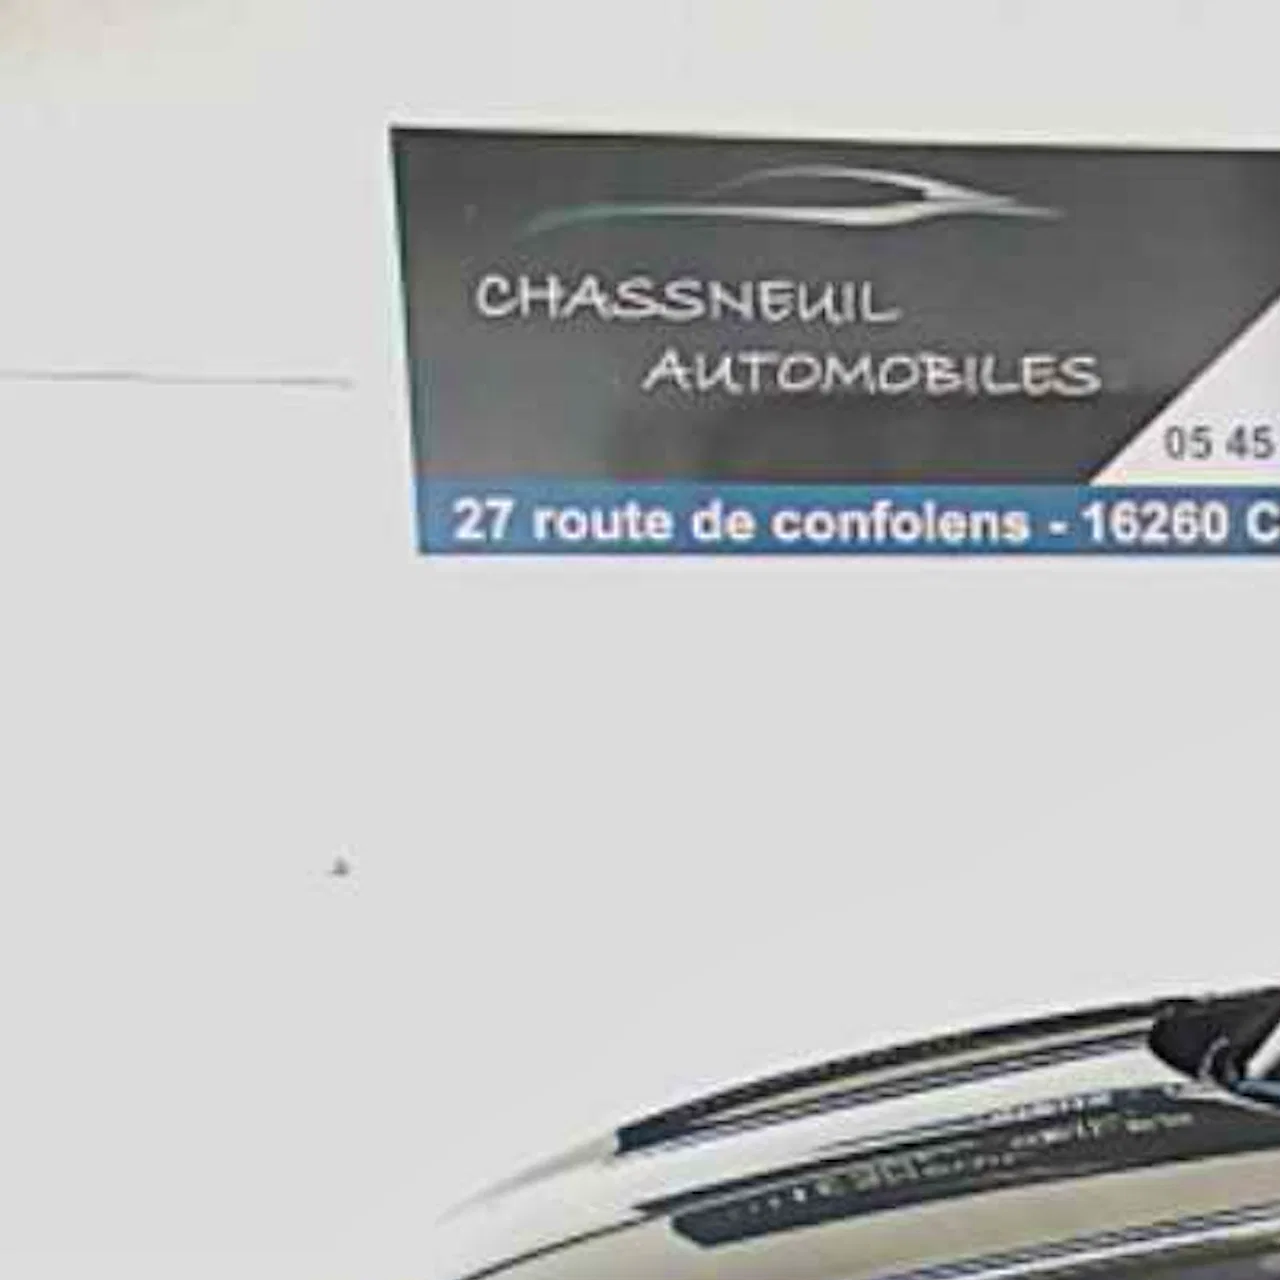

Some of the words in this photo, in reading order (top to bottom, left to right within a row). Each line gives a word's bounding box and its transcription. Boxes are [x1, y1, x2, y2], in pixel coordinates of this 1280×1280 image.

[474, 273, 902, 326] CHASSNEUIL
[641, 346, 1104, 398] AUTOMOBILES
[1164, 427, 1212, 461] 05
[1225, 427, 1276, 462] 45
[452, 498, 515, 541] 27
[533, 502, 674, 543] route
[690, 495, 757, 543] de
[772, 497, 1032, 545] confolens
[1081, 502, 1230, 545] 16260
